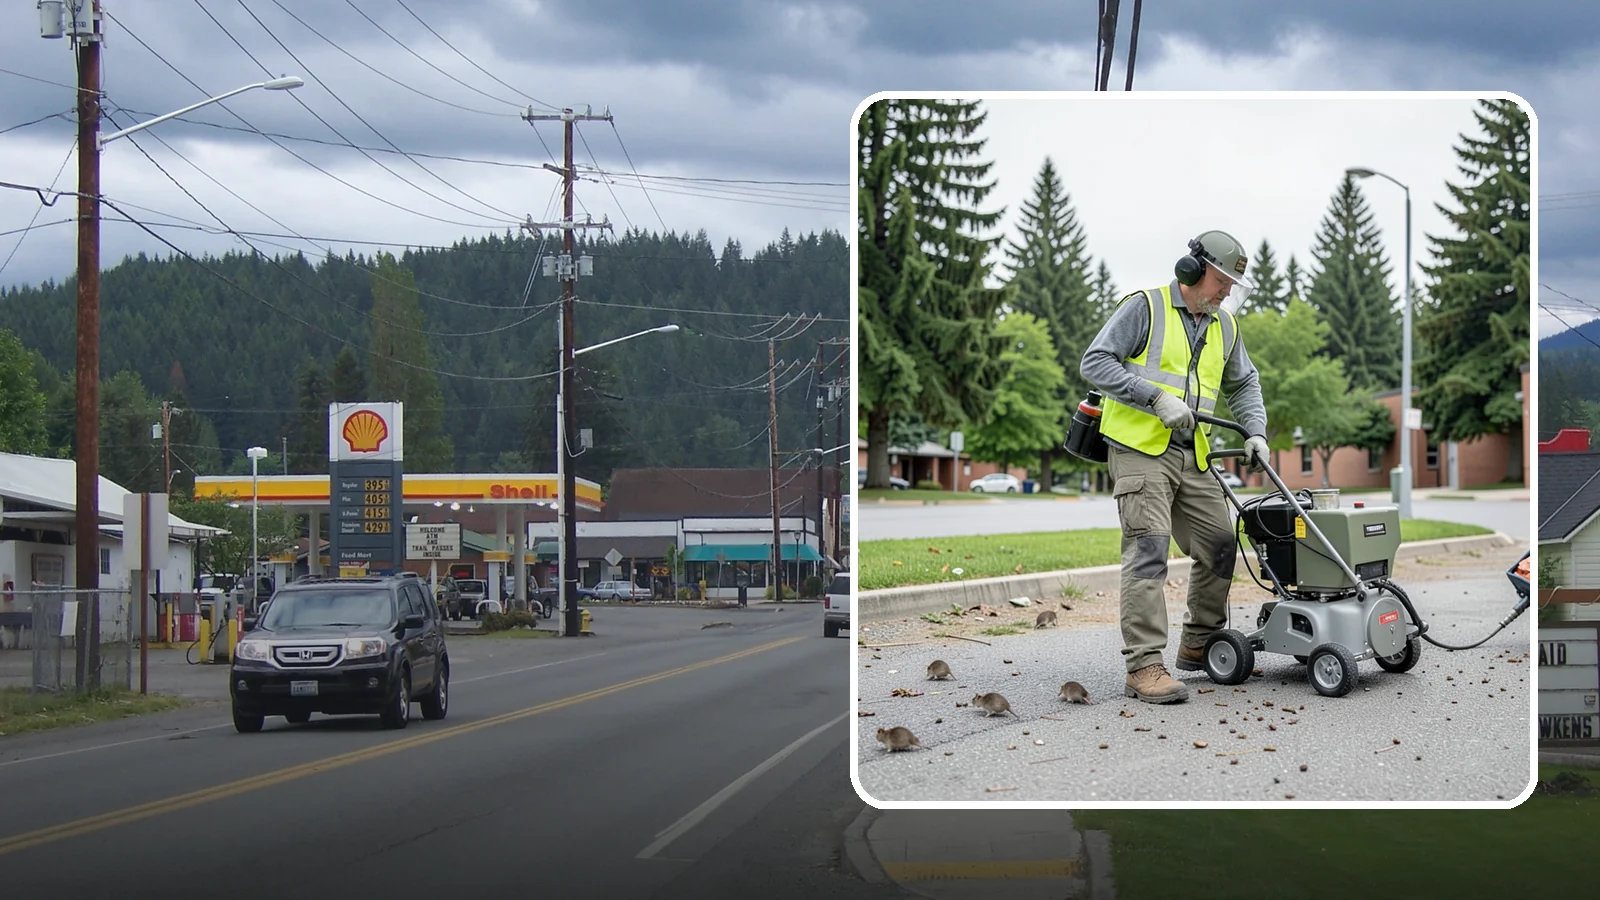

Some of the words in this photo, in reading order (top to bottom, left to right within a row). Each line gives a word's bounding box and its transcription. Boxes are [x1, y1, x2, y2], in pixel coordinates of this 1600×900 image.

[366, 480, 384, 490] 395
[490, 484, 547, 499] Shell
[366, 494, 384, 504] 405
[366, 508, 384, 518] 415
[366, 522, 384, 532] 429
